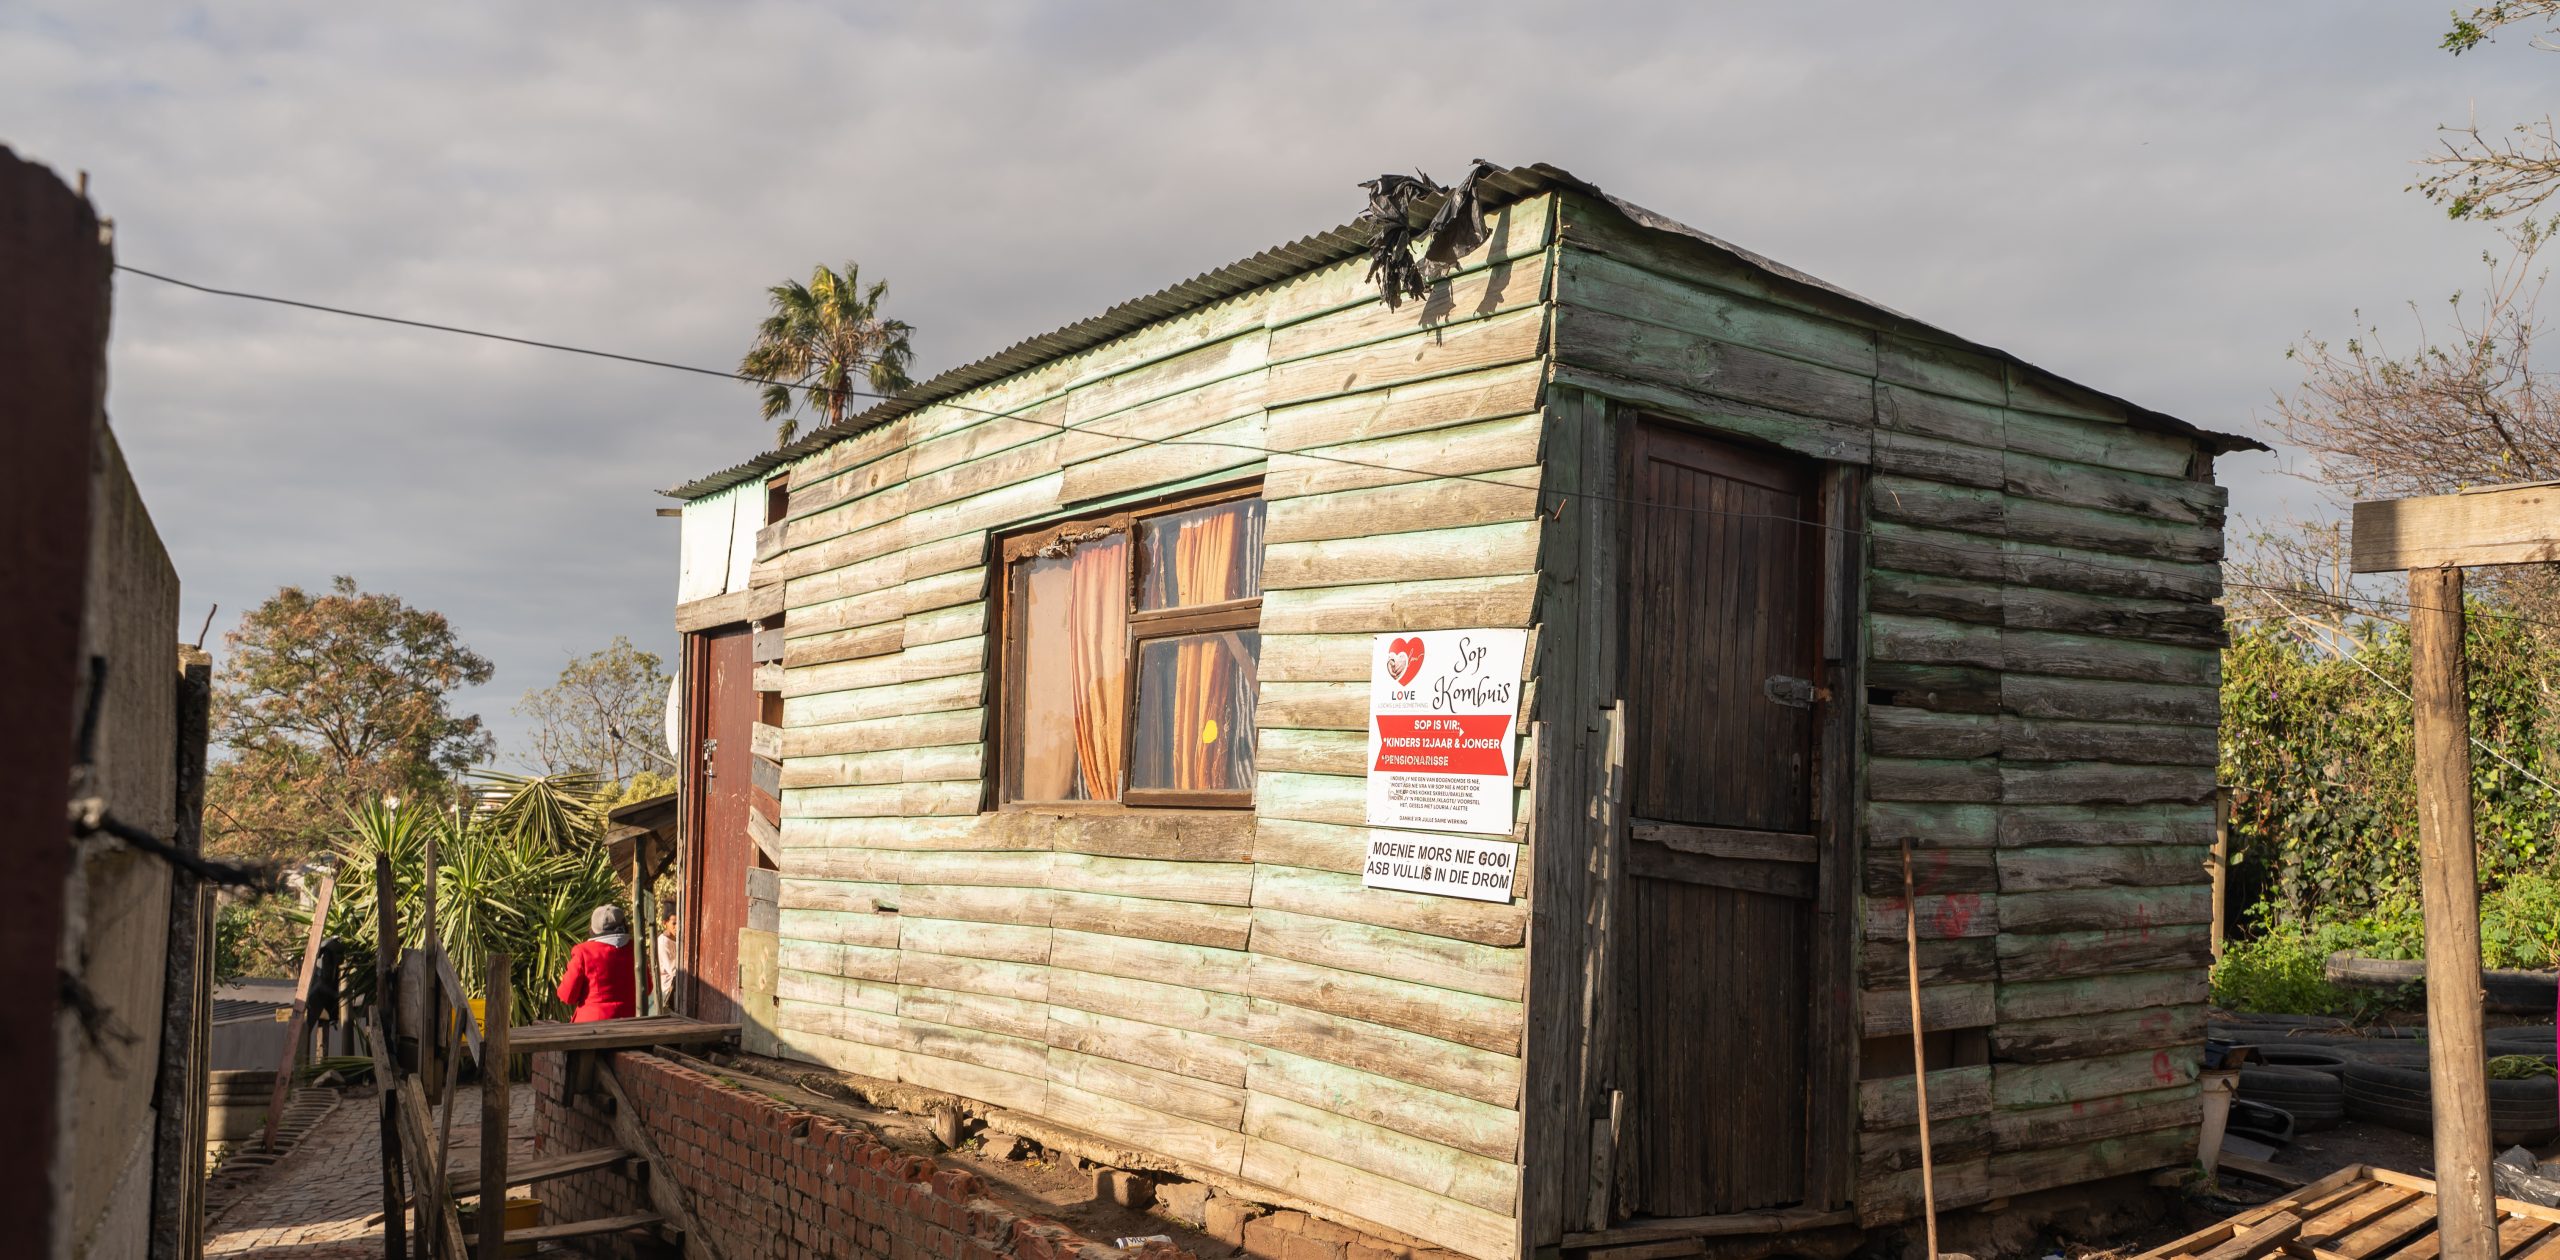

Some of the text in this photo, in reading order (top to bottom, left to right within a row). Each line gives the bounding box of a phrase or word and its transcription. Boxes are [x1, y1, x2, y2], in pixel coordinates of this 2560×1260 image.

[1454, 636, 1487, 675] Sop
[1391, 690, 1416, 701] LOVE
[1432, 675, 1511, 714] Kombuis
[1414, 719, 1460, 730] SOP IS VIR:
[1422, 738, 1453, 749] 12JAAR
[1454, 738, 1460, 749] &
[1462, 738, 1500, 749] JONGER
[1372, 841, 1511, 868] MOENIE MORS NIE GOOI
[1366, 860, 1510, 889] ASB VULLIS IN DIE DROM
